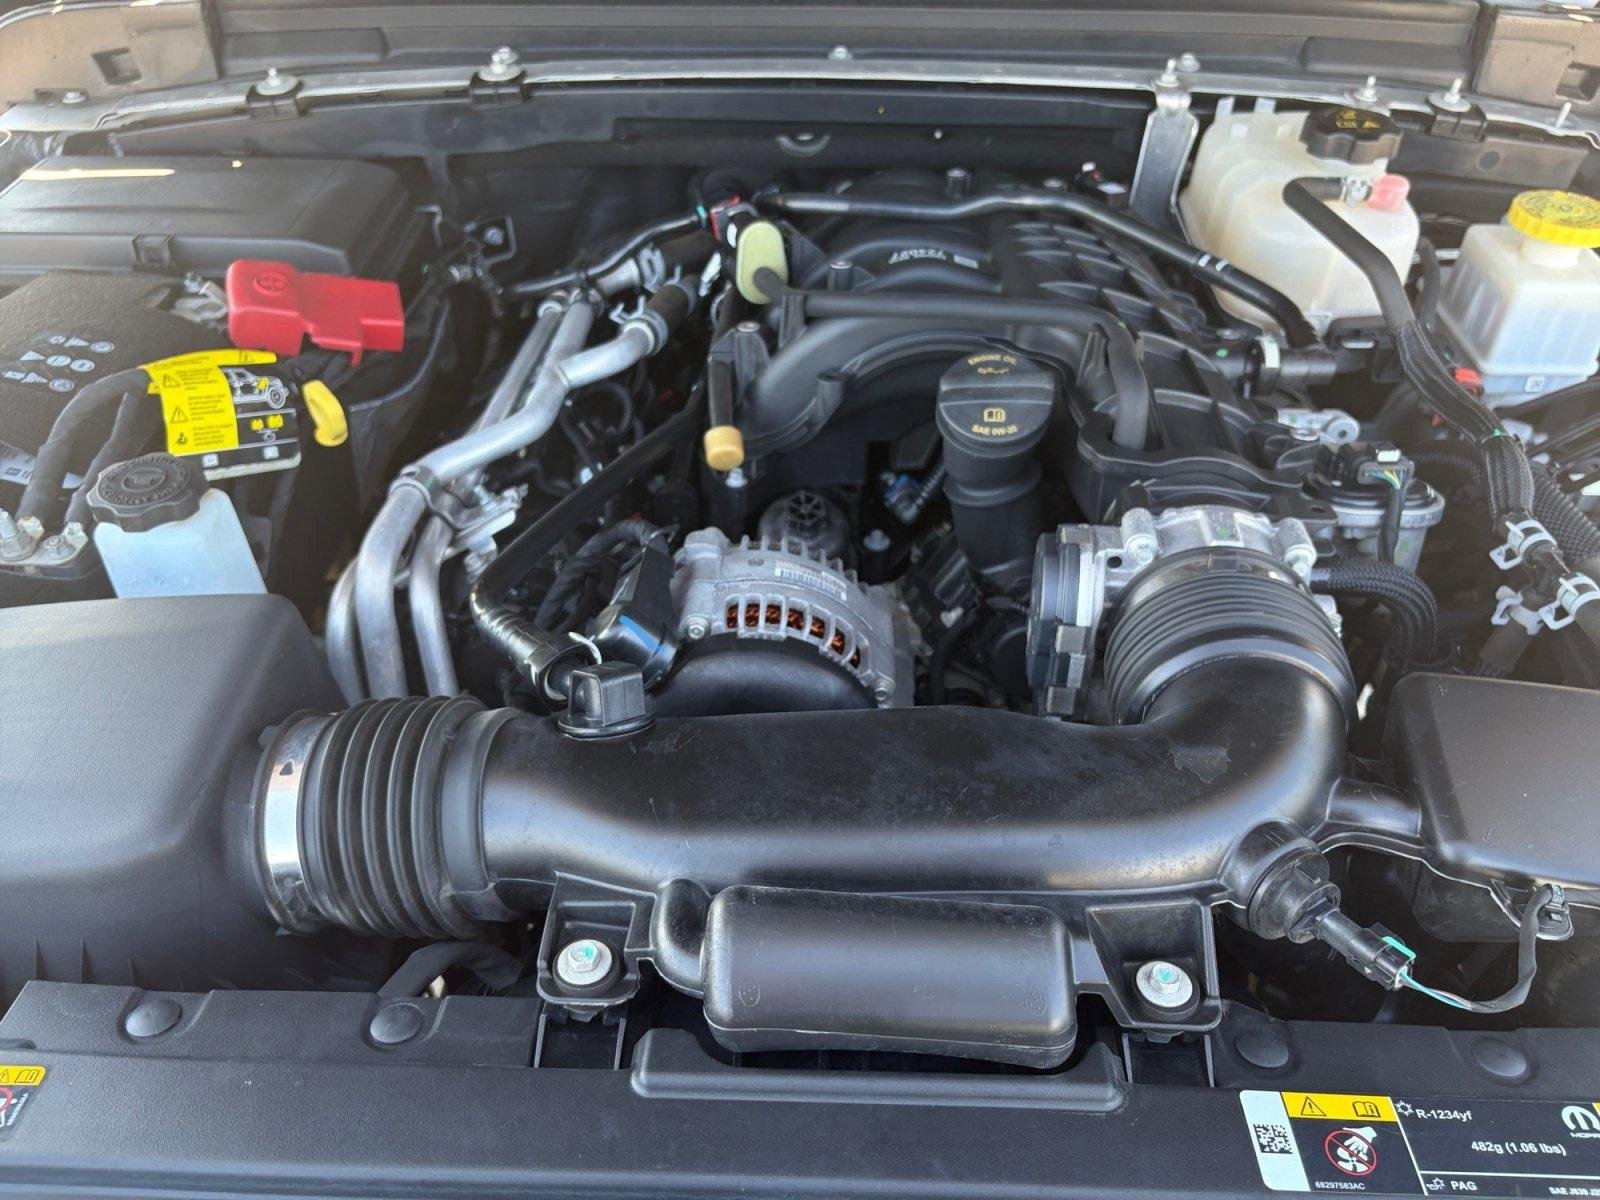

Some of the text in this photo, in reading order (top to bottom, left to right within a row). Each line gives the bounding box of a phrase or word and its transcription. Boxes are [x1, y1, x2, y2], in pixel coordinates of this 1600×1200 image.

[968, 353, 1017, 365] ENGINE OIL
[972, 424, 1018, 436] SAE 0W-20
[1415, 1108, 1473, 1122] R-1234yf
[1471, 1141, 1567, 1156] 482g (1.06 lbs)
[1450, 1180, 1478, 1191] PAG
